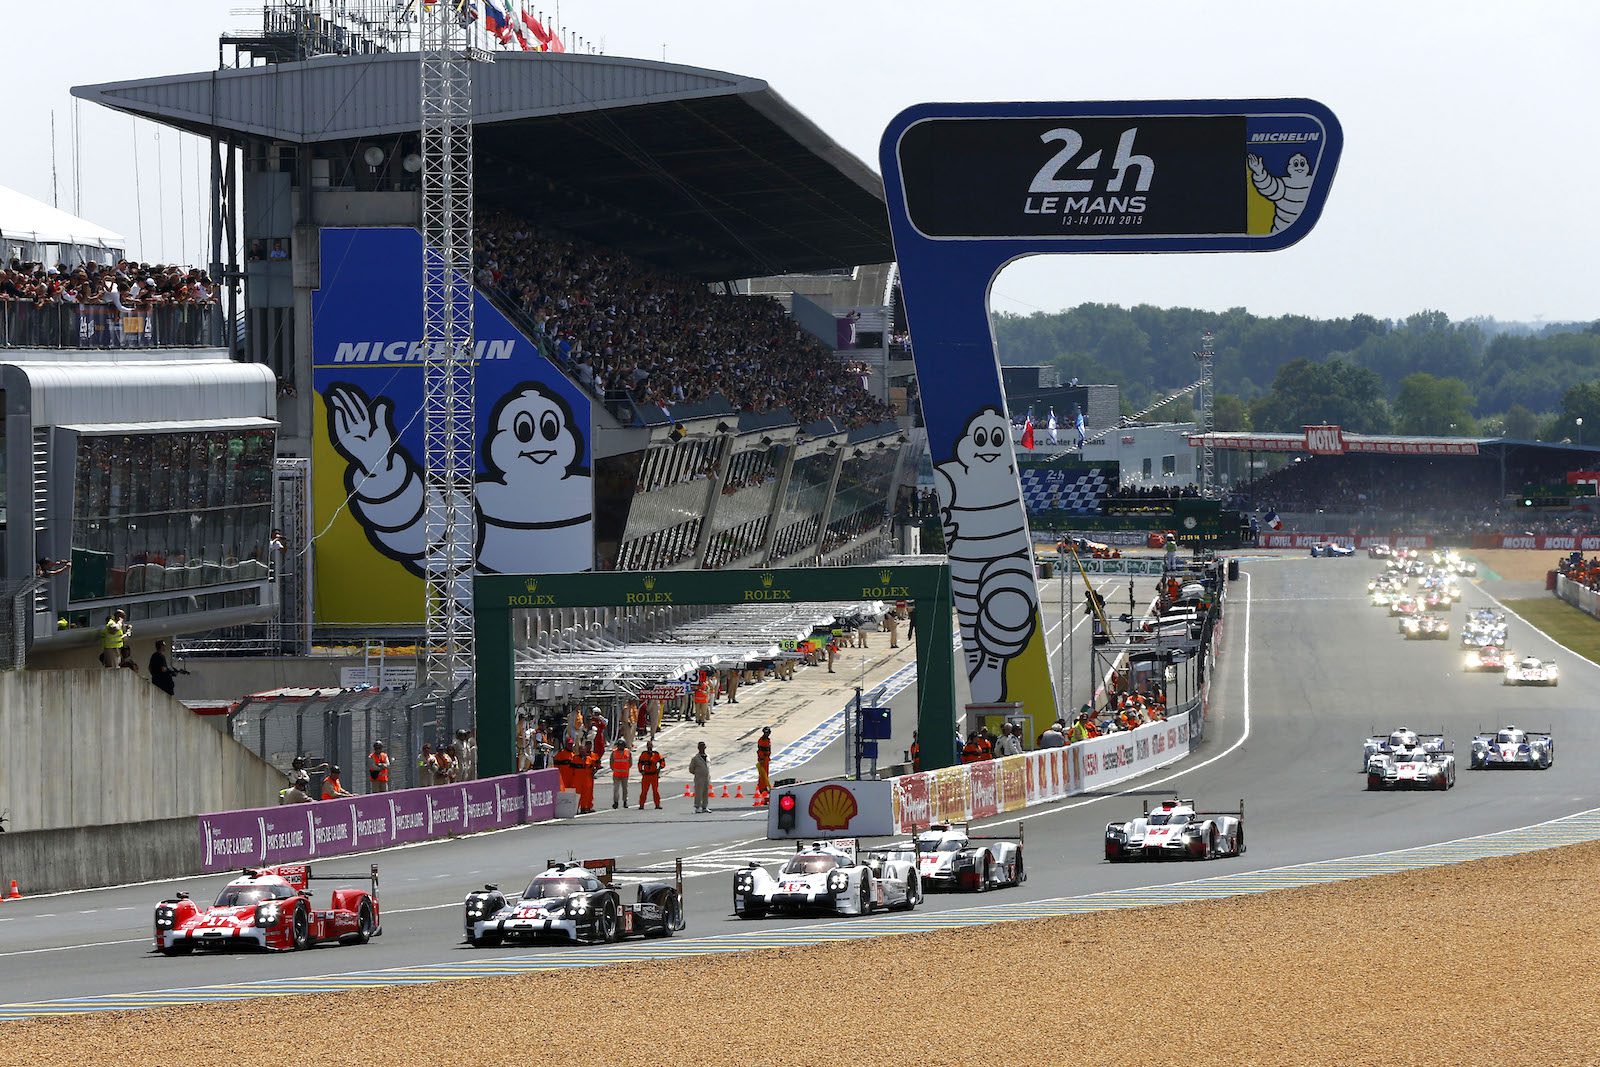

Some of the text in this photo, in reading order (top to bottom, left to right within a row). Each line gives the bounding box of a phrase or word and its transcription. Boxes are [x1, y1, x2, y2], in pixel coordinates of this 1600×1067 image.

[1251, 132, 1319, 142] MICHELIN
[1028, 127, 1155, 193] 24h
[1024, 196, 1147, 214] LE MANS
[1062, 216, 1143, 225] 13-14 JUIN 2015
[1308, 430, 1341, 450] MOTUL
[1503, 537, 1536, 549] MOTUL
[1544, 537, 1575, 549] MOTUL
[507, 586, 909, 606] ROLEX ROLEX ROLEX ROLEX
[784, 640, 795, 649] 66
[665, 690, 675, 699] 23
[214, 839, 226, 855] PAYS
[240, 837, 253, 854] LOIRE
[268, 834, 278, 850] PAYS
[292, 830, 303, 846] LOIRE
[280, 866, 305, 875] PORSCHE
[518, 908, 538, 919] 18
[208, 917, 226, 926] 17
[317, 920, 325, 937] 17
